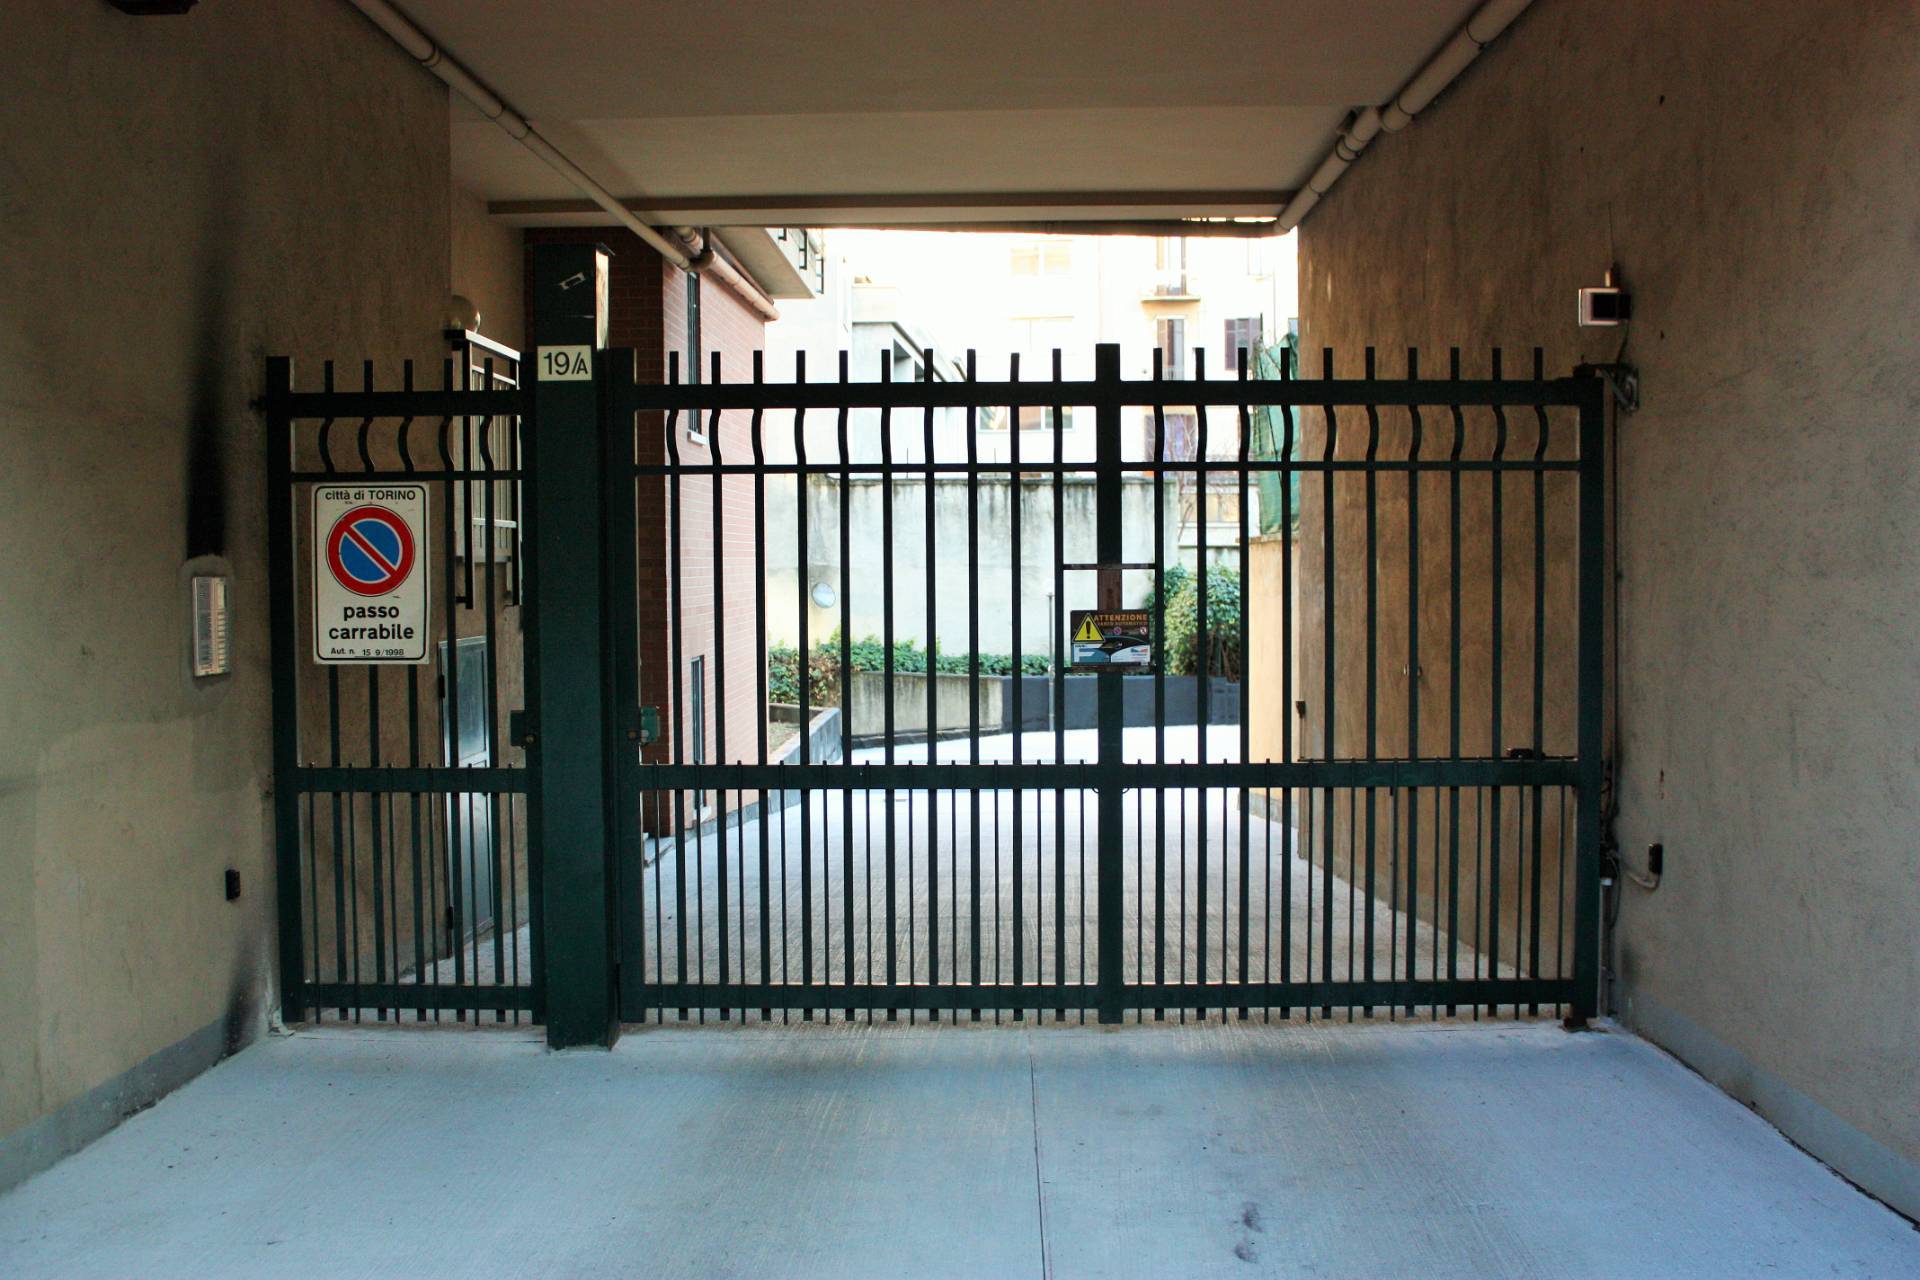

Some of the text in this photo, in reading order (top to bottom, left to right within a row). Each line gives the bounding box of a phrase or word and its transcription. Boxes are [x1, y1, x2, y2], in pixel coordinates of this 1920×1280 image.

[543, 351, 588, 375] 19/A
[325, 489, 416, 500] città di TORINO
[343, 605, 400, 621] passo
[328, 624, 414, 640] carrabile
